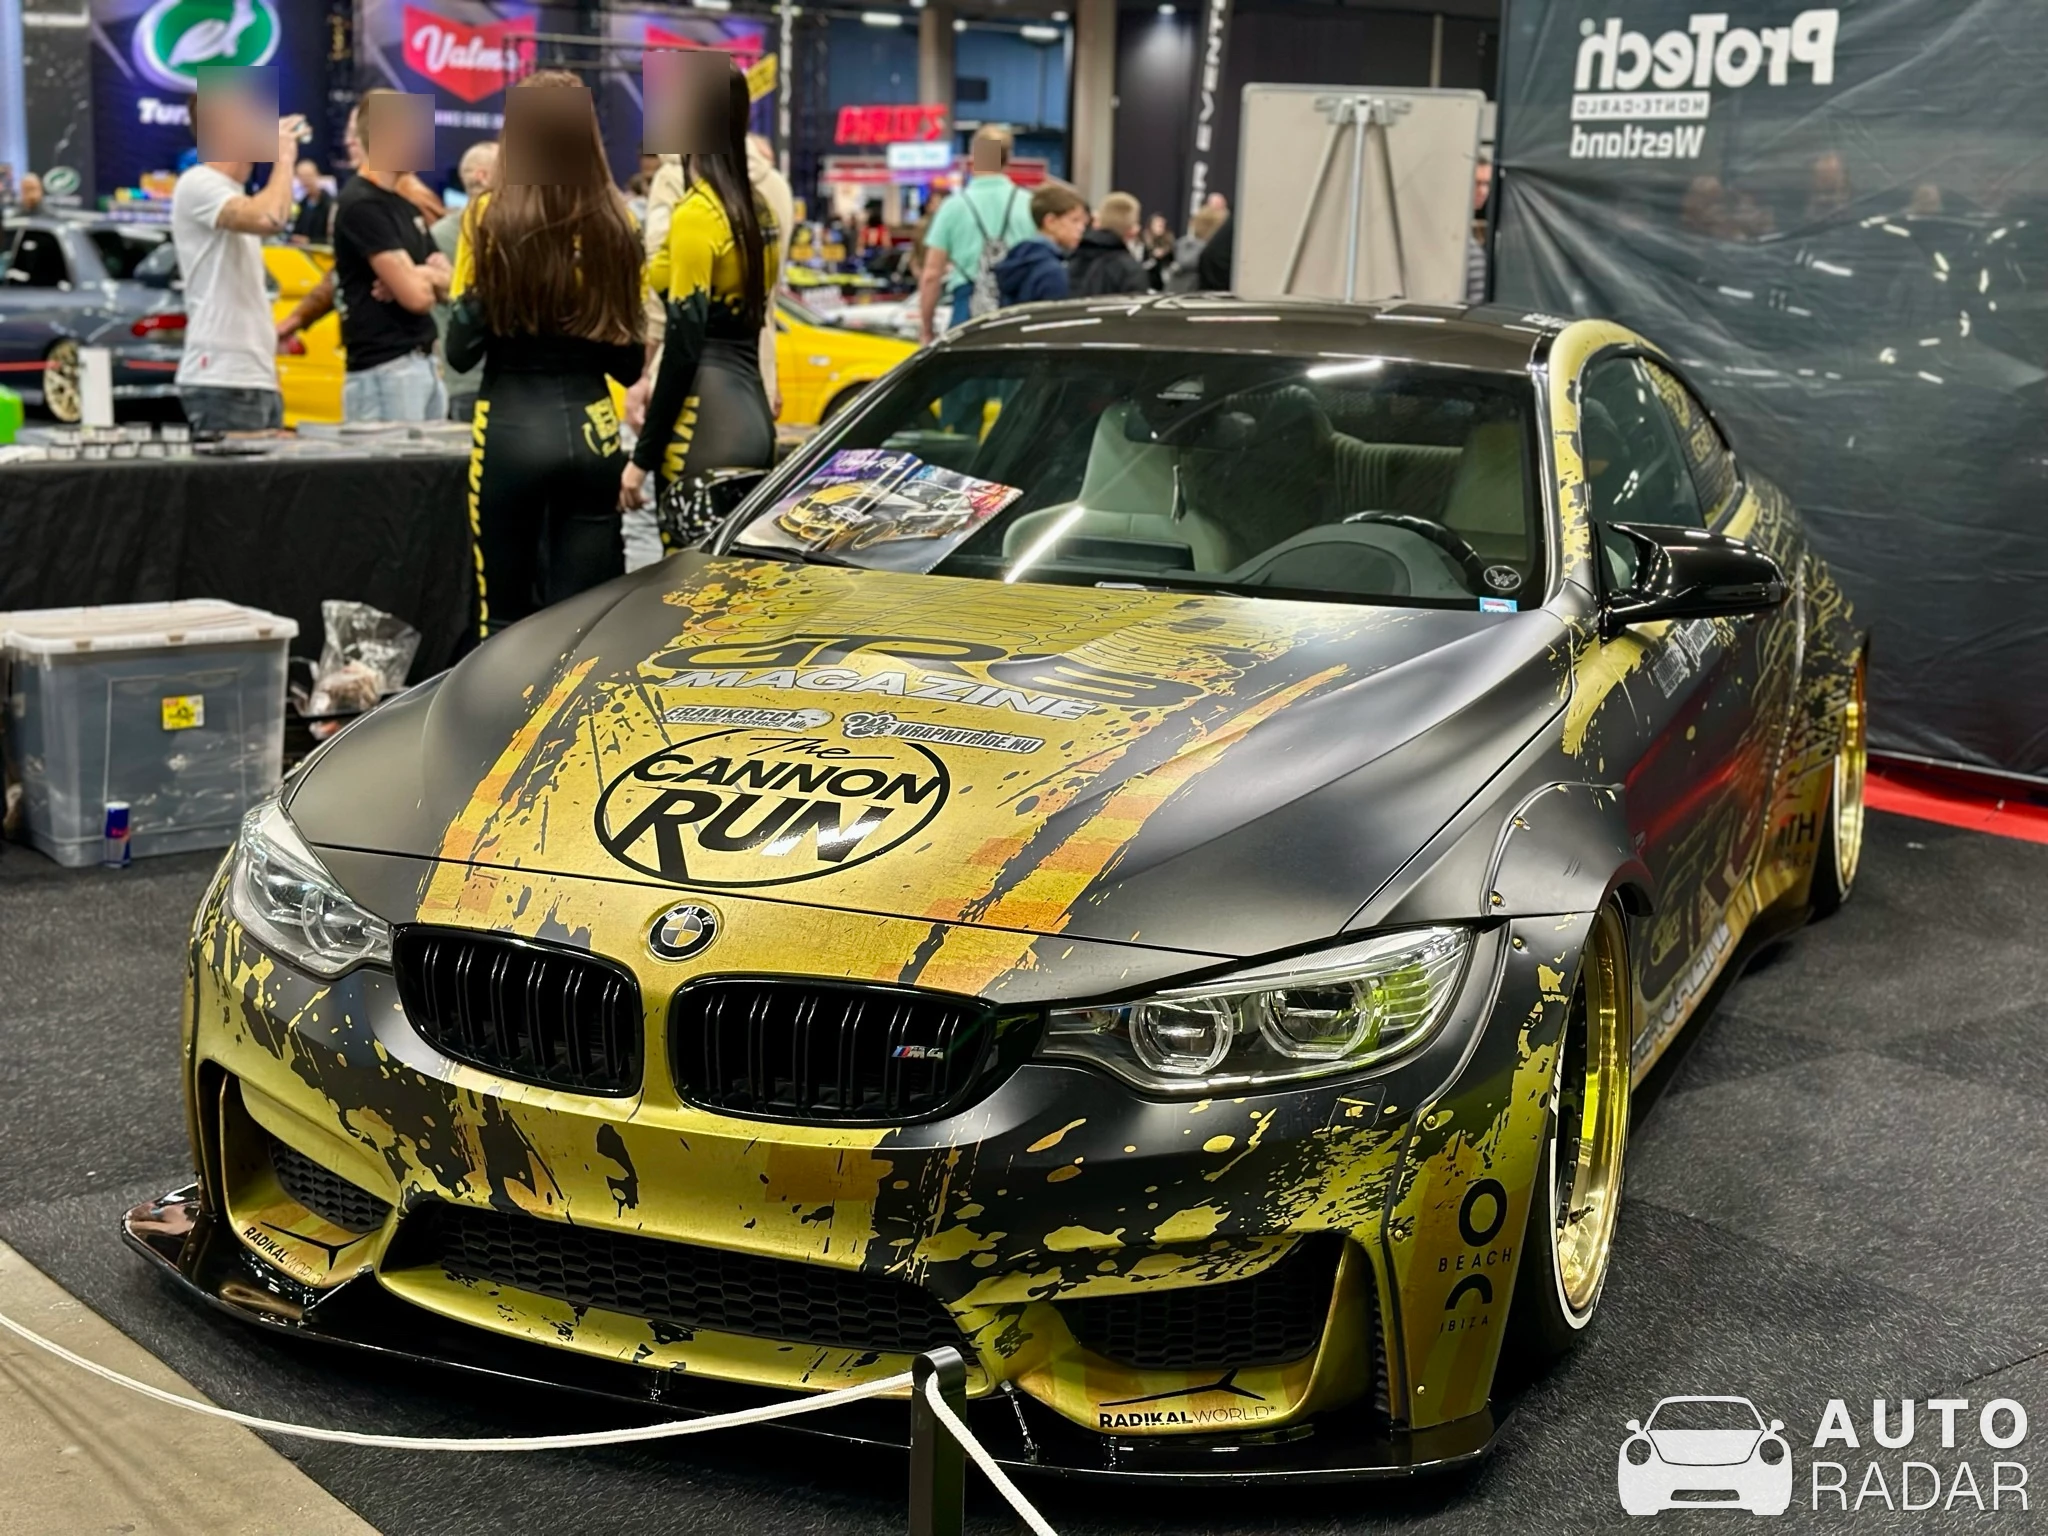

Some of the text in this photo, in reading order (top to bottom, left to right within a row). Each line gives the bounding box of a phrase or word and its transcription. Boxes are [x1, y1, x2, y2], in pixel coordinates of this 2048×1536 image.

[663, 668, 1100, 719] MAGAZINE
[746, 738, 895, 760] The
[891, 723, 1039, 751] WRAPMYRIDE.NU
[633, 754, 942, 805] CANNON
[613, 786, 895, 880] RUN
[664, 906, 715, 926] BMW
[243, 1226, 325, 1286] RADIKALWORLD
[1438, 1248, 1512, 1272] BEACH
[1439, 1315, 1488, 1332] IBIZA
